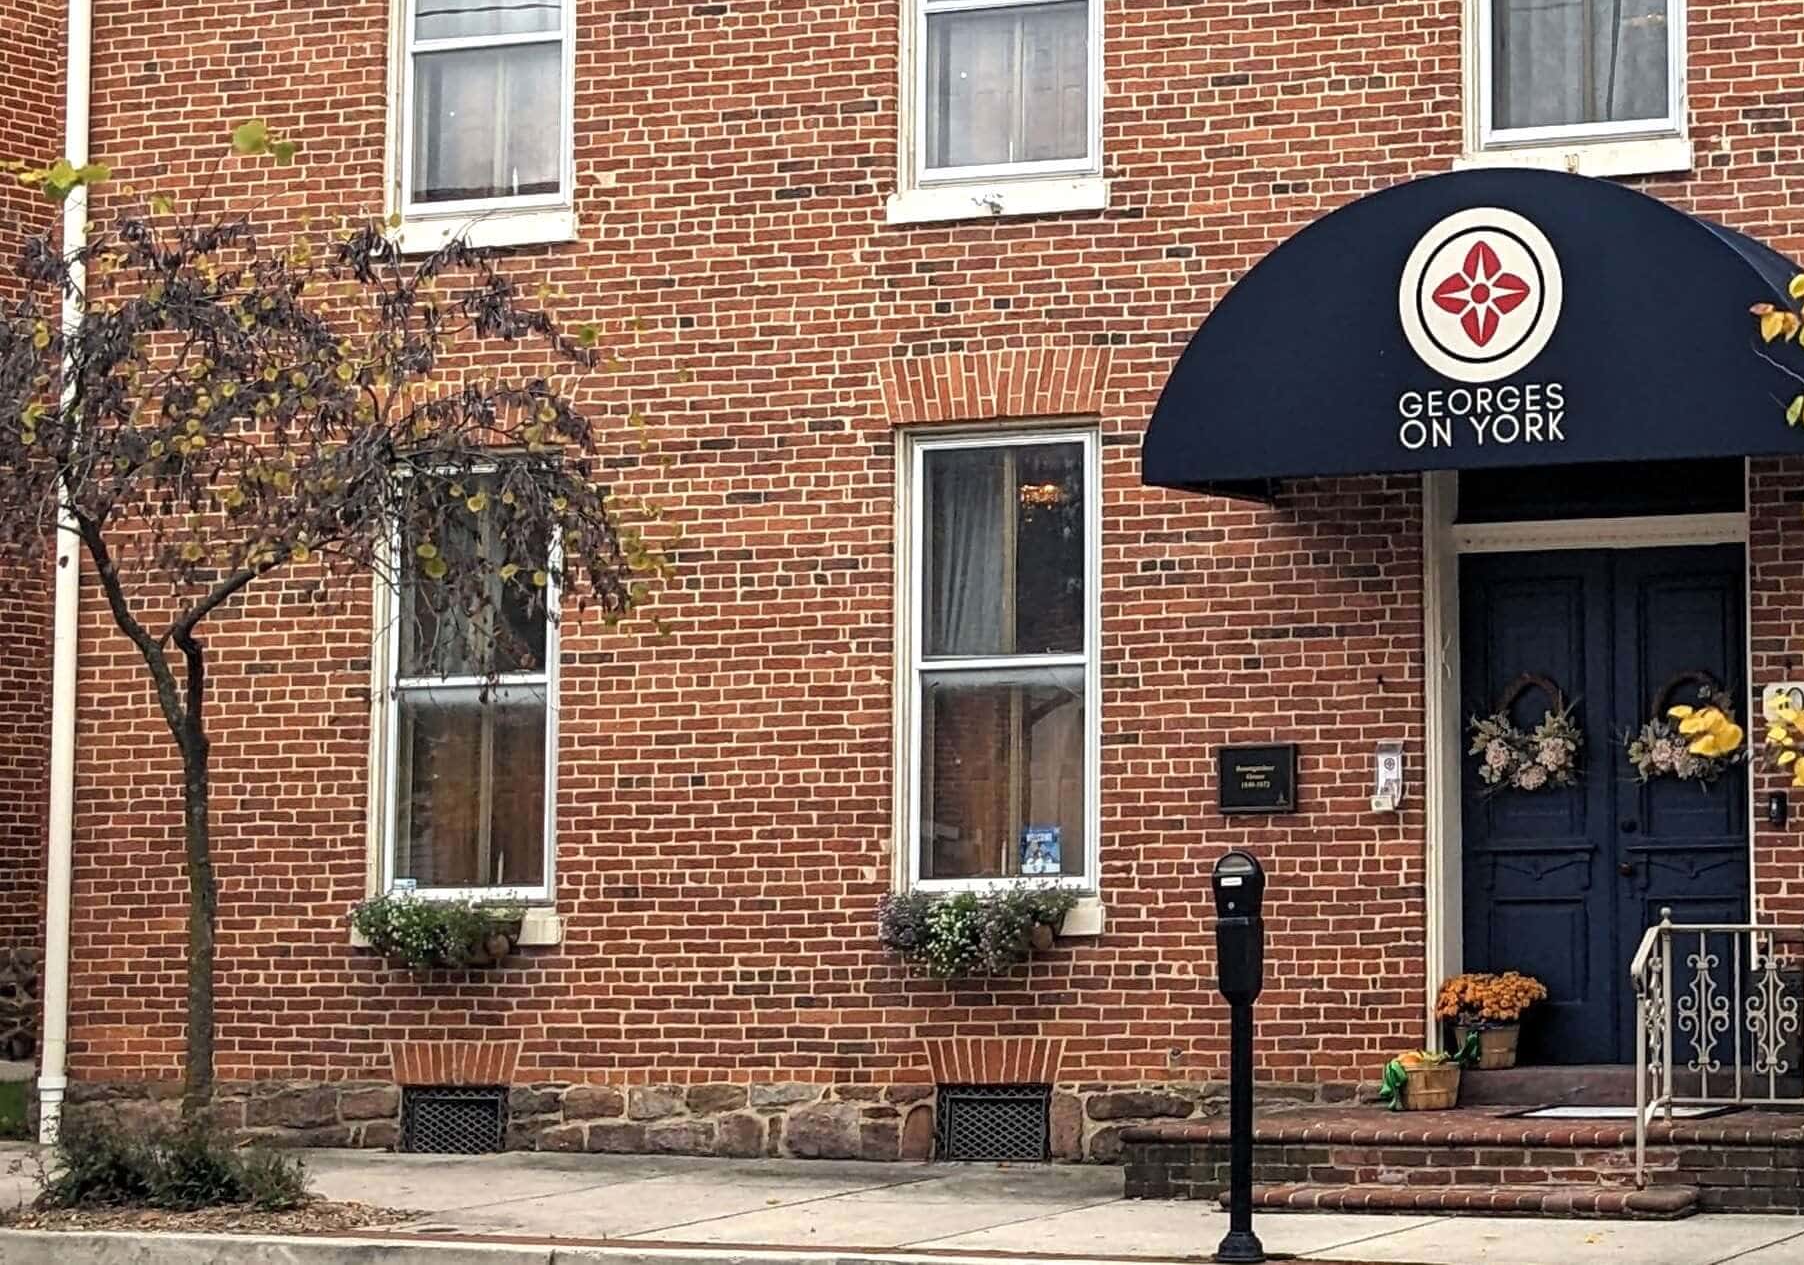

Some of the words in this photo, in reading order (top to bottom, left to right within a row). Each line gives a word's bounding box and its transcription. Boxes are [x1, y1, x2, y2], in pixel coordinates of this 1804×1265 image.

[1399, 383, 1565, 418] GEORGES
[1400, 418, 1452, 449] ON
[1469, 411, 1565, 445] YORK
